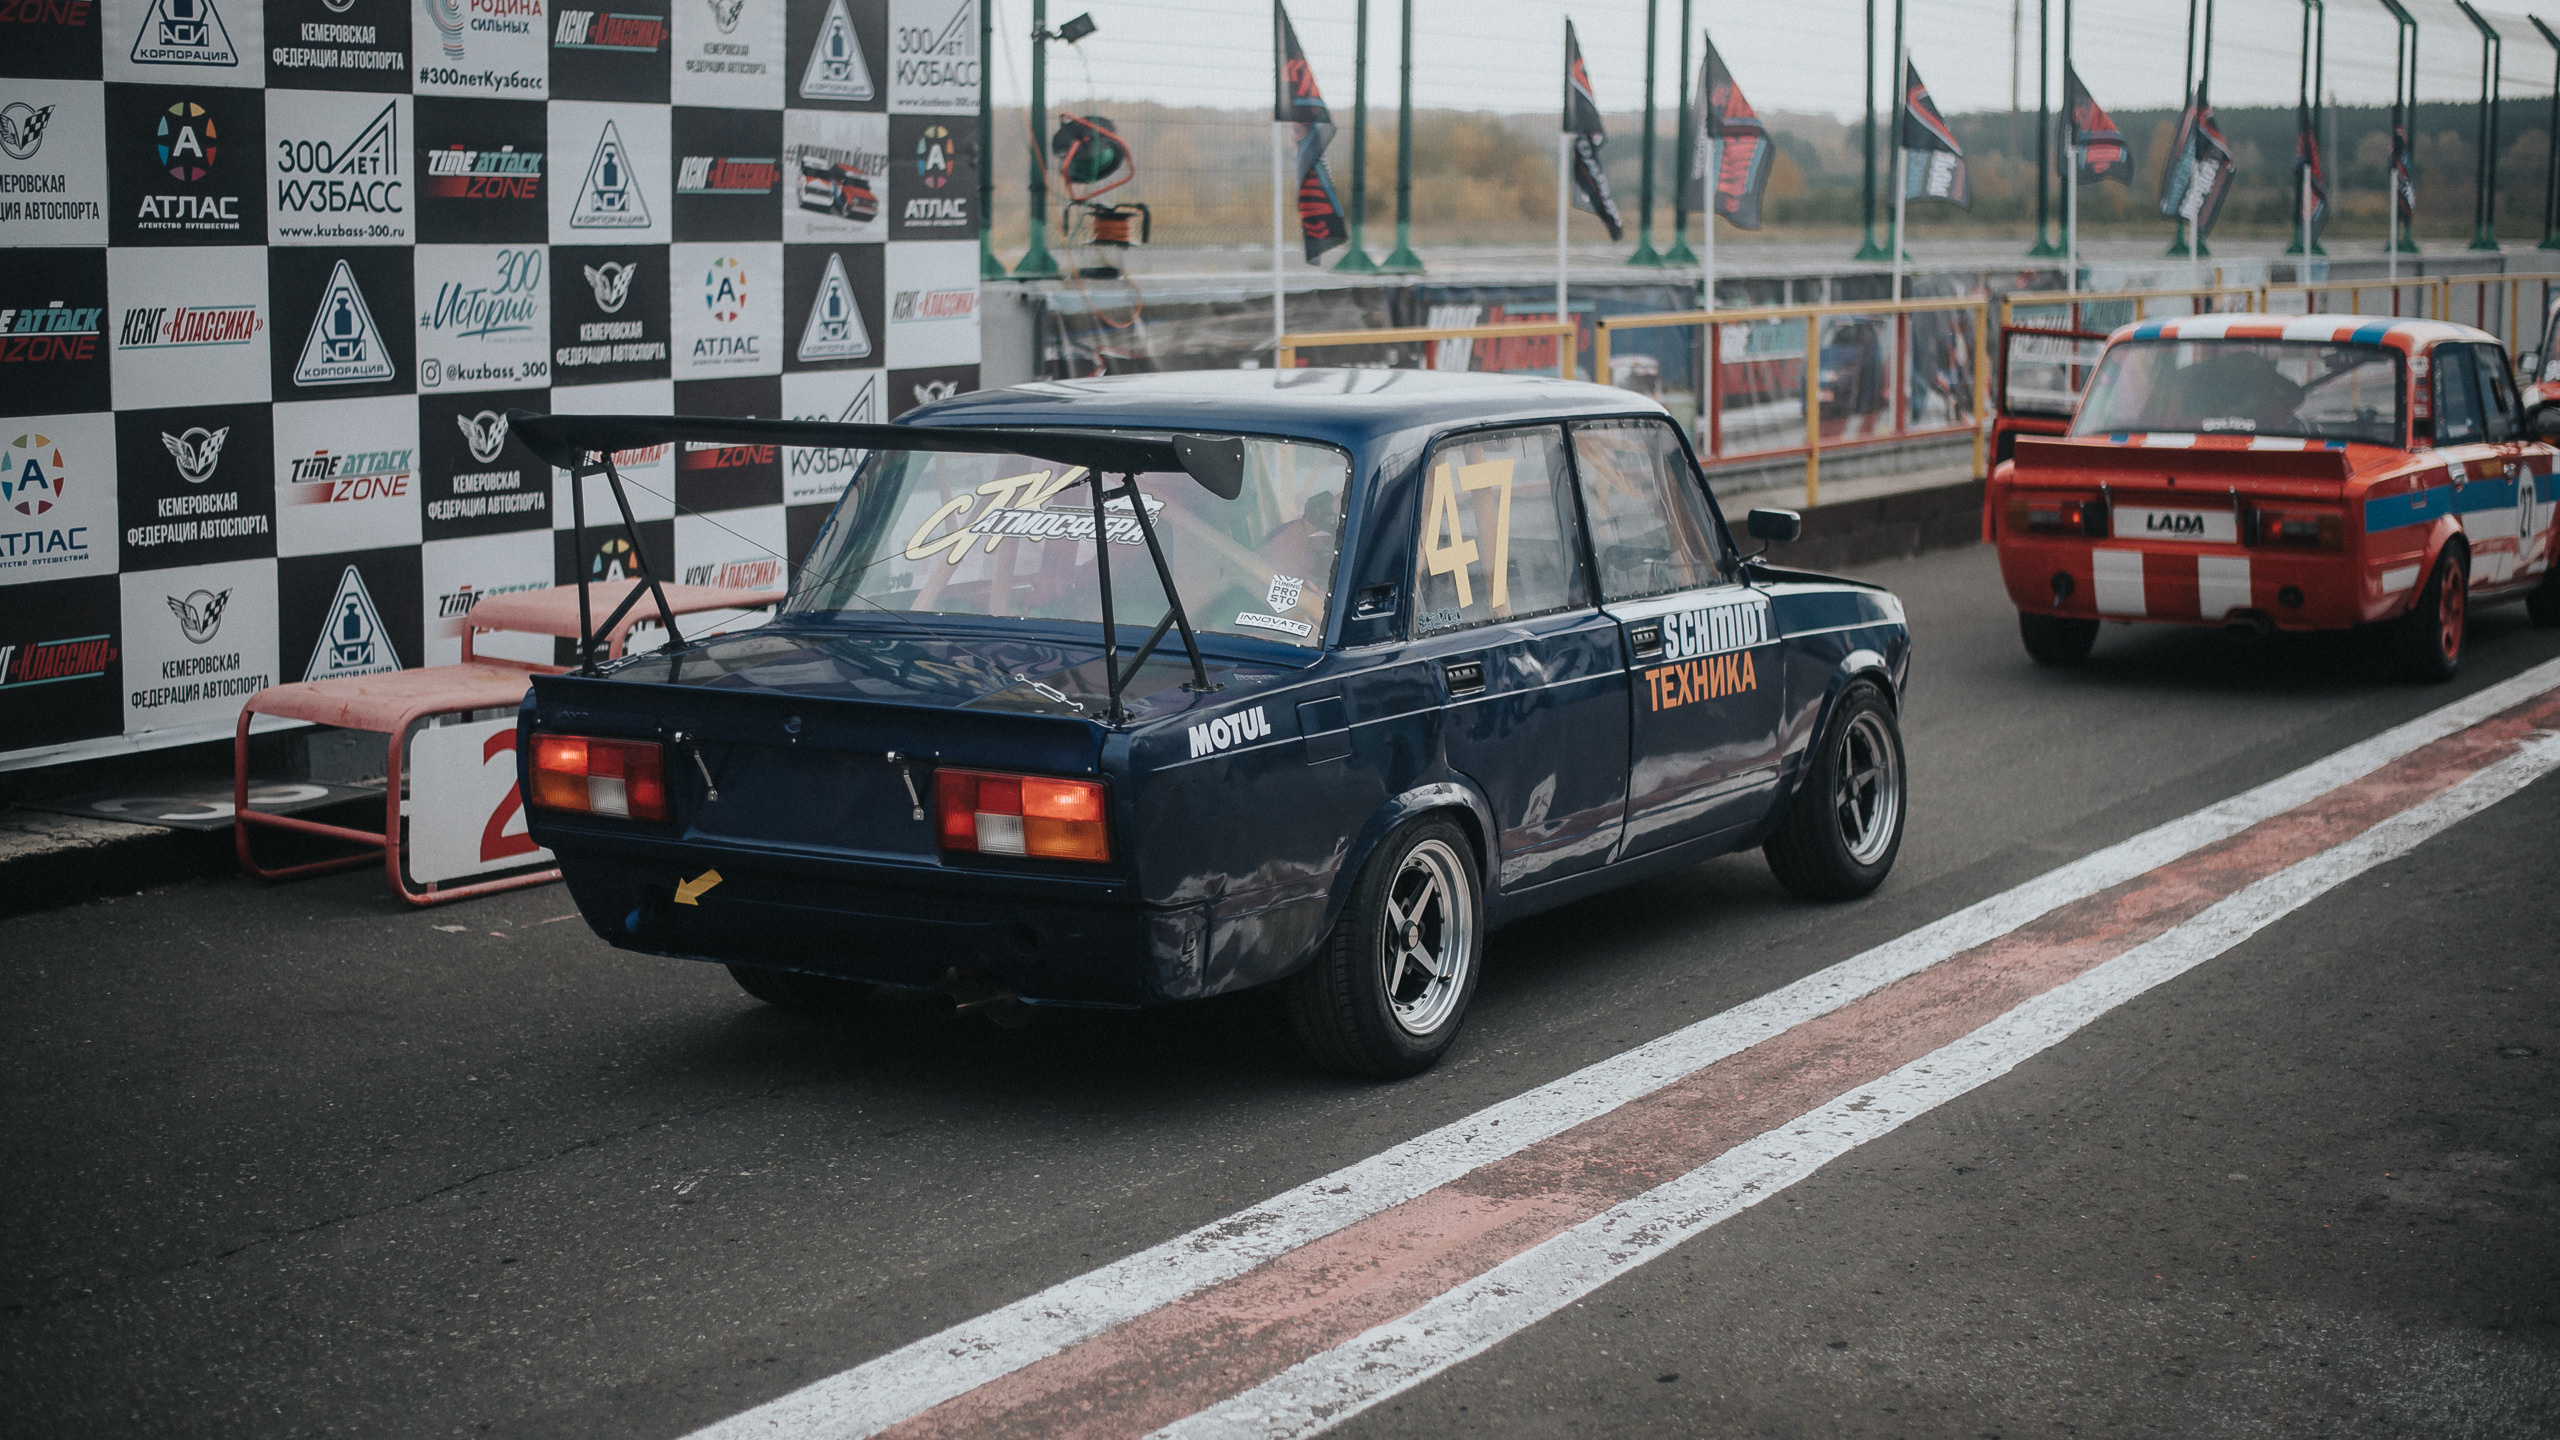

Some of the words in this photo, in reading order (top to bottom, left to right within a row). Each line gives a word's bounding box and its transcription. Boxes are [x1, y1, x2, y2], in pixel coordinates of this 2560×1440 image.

[161, 23, 209, 46] АСИ
[301, 23, 376, 44] КЕМЕРОВСКАЯ
[471, 18, 530, 34] СИЛЬНЫХ
[140, 49, 229, 61] КОРПОРАЦИЯ
[272, 47, 338, 69] ФЕДЕРАЦИЯ
[340, 50, 404, 71] АВТОСПОРТА
[419, 67, 542, 92] #300летКузбасс
[897, 60, 980, 87] КУЗБАСС
[278, 139, 332, 173] 300
[278, 180, 403, 213] КУЗБАСС
[467, 177, 540, 198] ZONE
[25, 202, 99, 220] АВТОСПОРТА
[138, 195, 239, 219] АТЛАС
[904, 197, 967, 219] АТЛАС
[186, 221, 240, 230] ПУТЕШЕСТВИЙ
[279, 224, 405, 238] www.kuzbass-300.ru
[491, 250, 542, 295] 300
[13, 303, 103, 332] ATTACK
[120, 308, 167, 345] КСКГ
[580, 321, 643, 341] КЕМЕРОВСКАЯ
[4, 336, 98, 362] ZONE
[322, 342, 366, 362] АСИ
[612, 343, 666, 362] АВТОСПОРТА
[694, 336, 759, 356] АТЛАС
[304, 365, 384, 377] КОРПОРАЦИЯ
[446, 362, 547, 381] @kuzbass_300
[341, 449, 413, 475] ATTACK
[717, 444, 775, 468] ZONE
[333, 474, 410, 502] ZONE
[453, 470, 520, 494] КЕМЕРОВСКАЯ
[158, 492, 237, 517] КЕМЕРОВСКАЯ
[428, 499, 486, 520] ФЕДЕРАЦИЯ
[487, 492, 545, 515] АВТОСПОРТА
[127, 522, 197, 547] ФЕДЕРАЦИЯ
[200, 515, 268, 540] АВТОСПОРТА
[1425, 458, 1514, 610] 47
[2146, 512, 2205, 534] LADA
[32, 553, 89, 565] ПУТЕШЕСТВИЙ
[1272, 586, 1298, 597] PRO
[1274, 580, 1301, 589] TUNING
[1269, 594, 1296, 605] STO
[1240, 613, 1309, 632] INNOVATE
[1663, 601, 1767, 659] SCHMIDT
[162, 653, 240, 679] КЕМЕРОВСКАЯ
[331, 645, 375, 669] АСИ
[131, 687, 199, 709] ФЕДЕРАЦИЯ
[203, 674, 269, 700] АВТОСПОРТА
[1645, 651, 1757, 712] ТЕХНИКА
[1188, 705, 1271, 759] MOTUL
